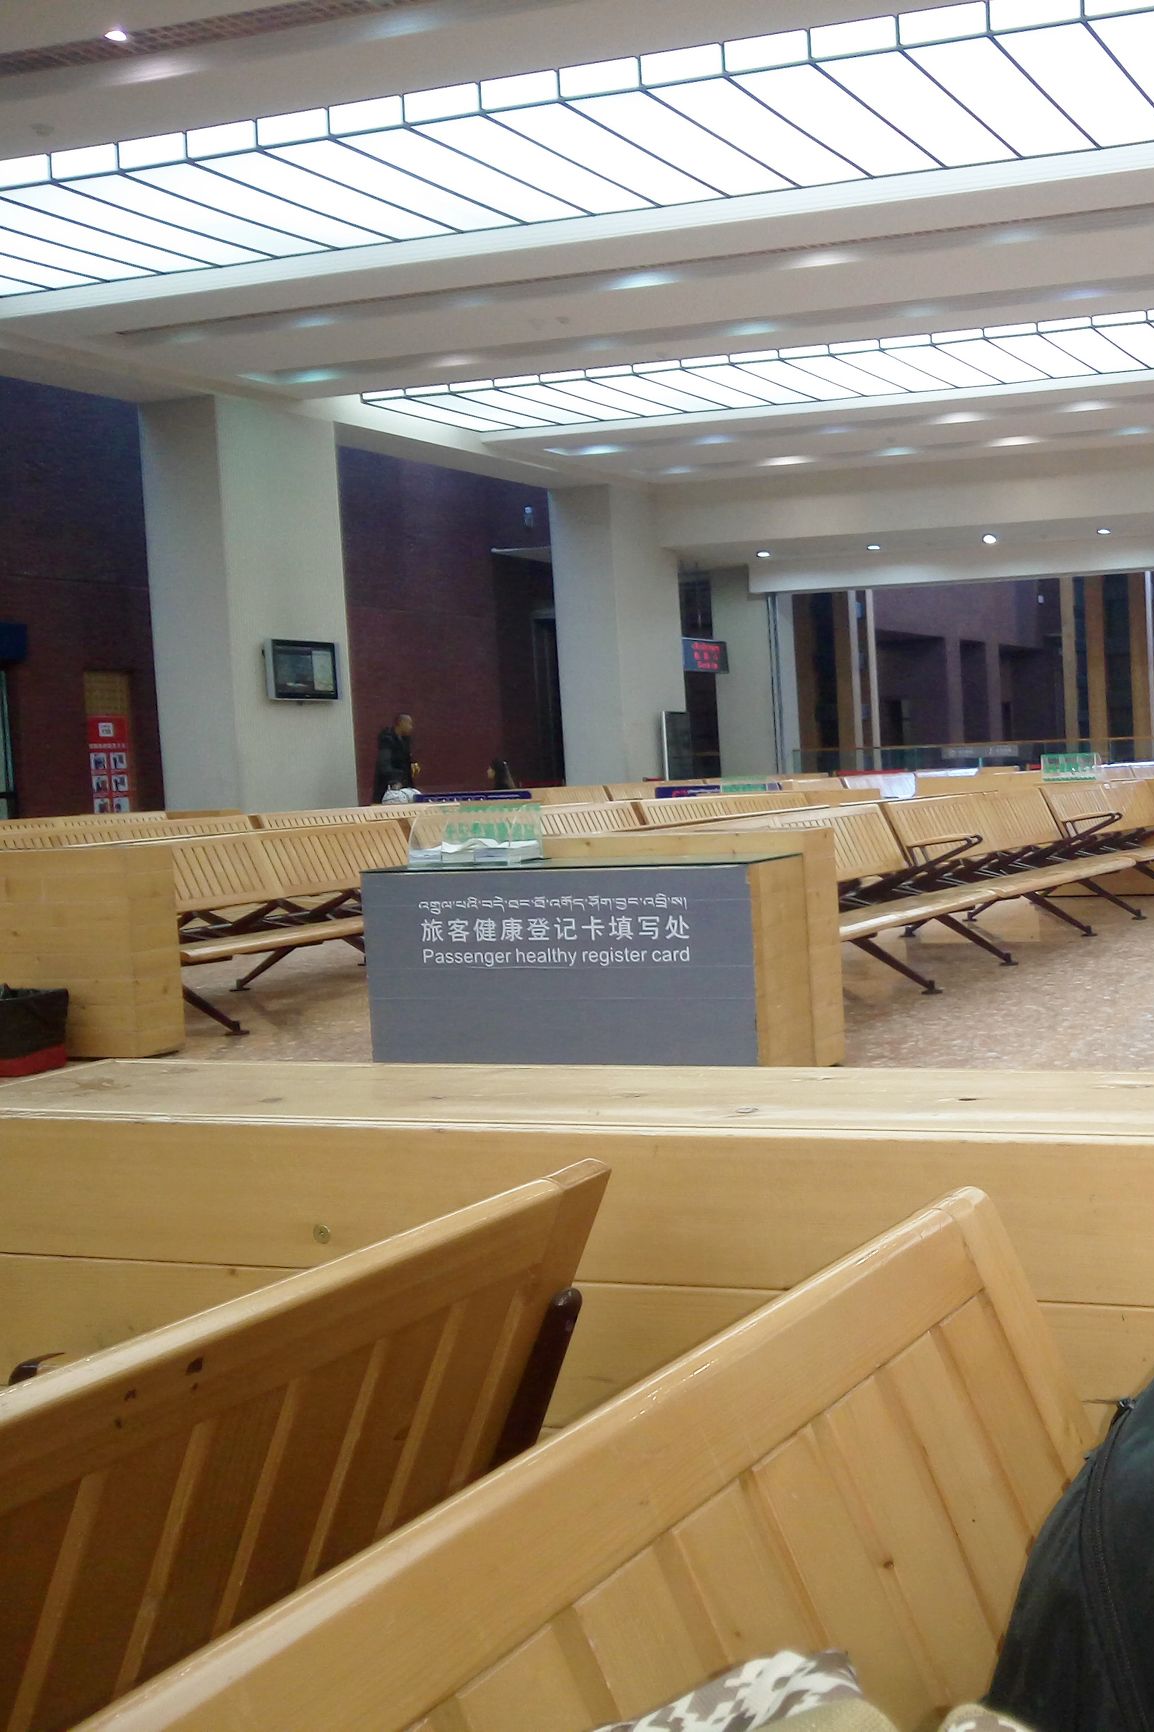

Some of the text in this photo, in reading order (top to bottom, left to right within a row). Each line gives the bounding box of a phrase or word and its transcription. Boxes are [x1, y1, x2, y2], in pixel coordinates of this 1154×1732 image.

[421, 915, 690, 942] 旅客健康登记卡填写处
[422, 946, 690, 967] Passenger healthy register card
